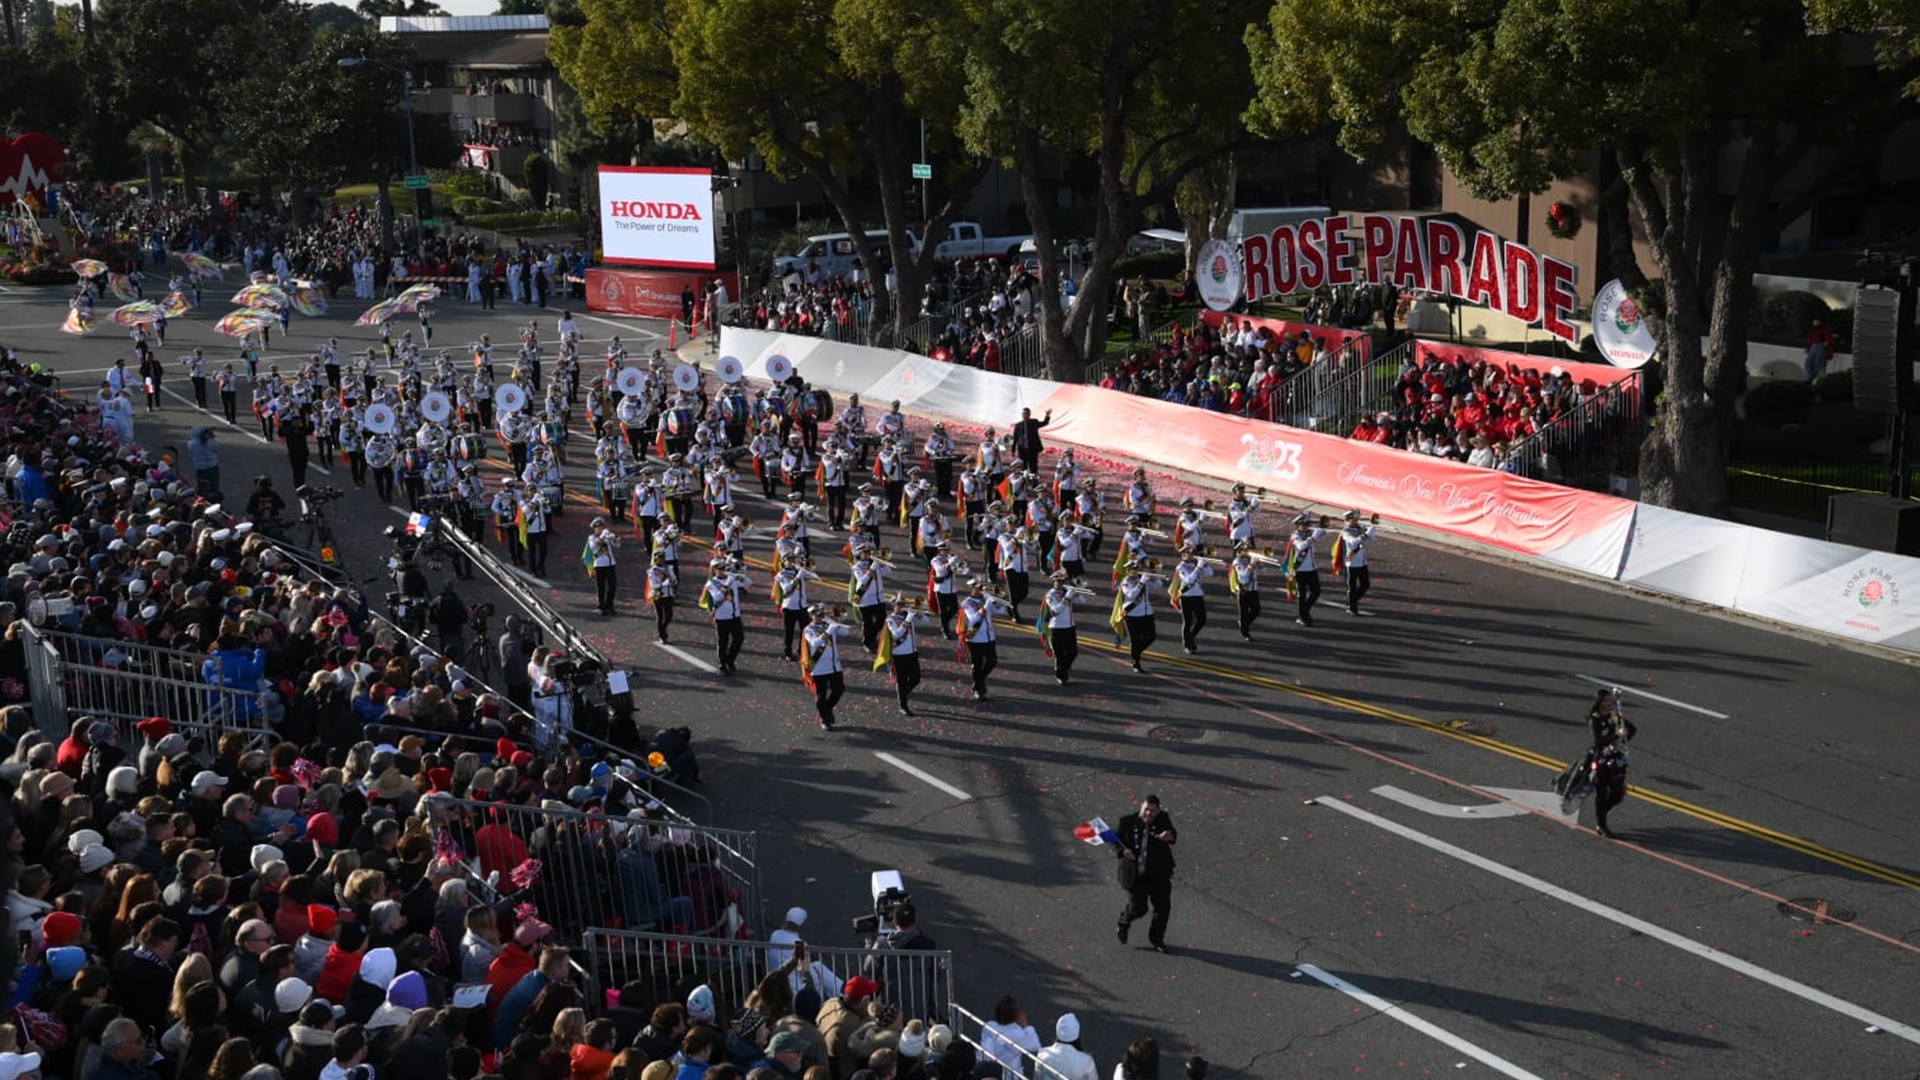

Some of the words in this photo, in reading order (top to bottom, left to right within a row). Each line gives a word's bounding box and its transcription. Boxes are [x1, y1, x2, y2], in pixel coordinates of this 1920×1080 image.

[611, 201, 702, 220] HONDA
[615, 221, 630, 230] The
[631, 222, 656, 231] Power
[657, 223, 665, 232] of
[667, 223, 699, 233] Dreams
[1243, 215, 1354, 302] ROSE
[1363, 215, 1577, 343] PARADE
[1599, 286, 1618, 323] ROSE
[1609, 349, 1646, 361] HONDA
[1336, 461, 1396, 492] America's
[1399, 474, 1436, 501] New
[1438, 482, 1475, 513] Year
[1477, 491, 1554, 529] Celebration
[1843, 569, 1866, 597] ROSE
[1870, 567, 1899, 608] PARADE
